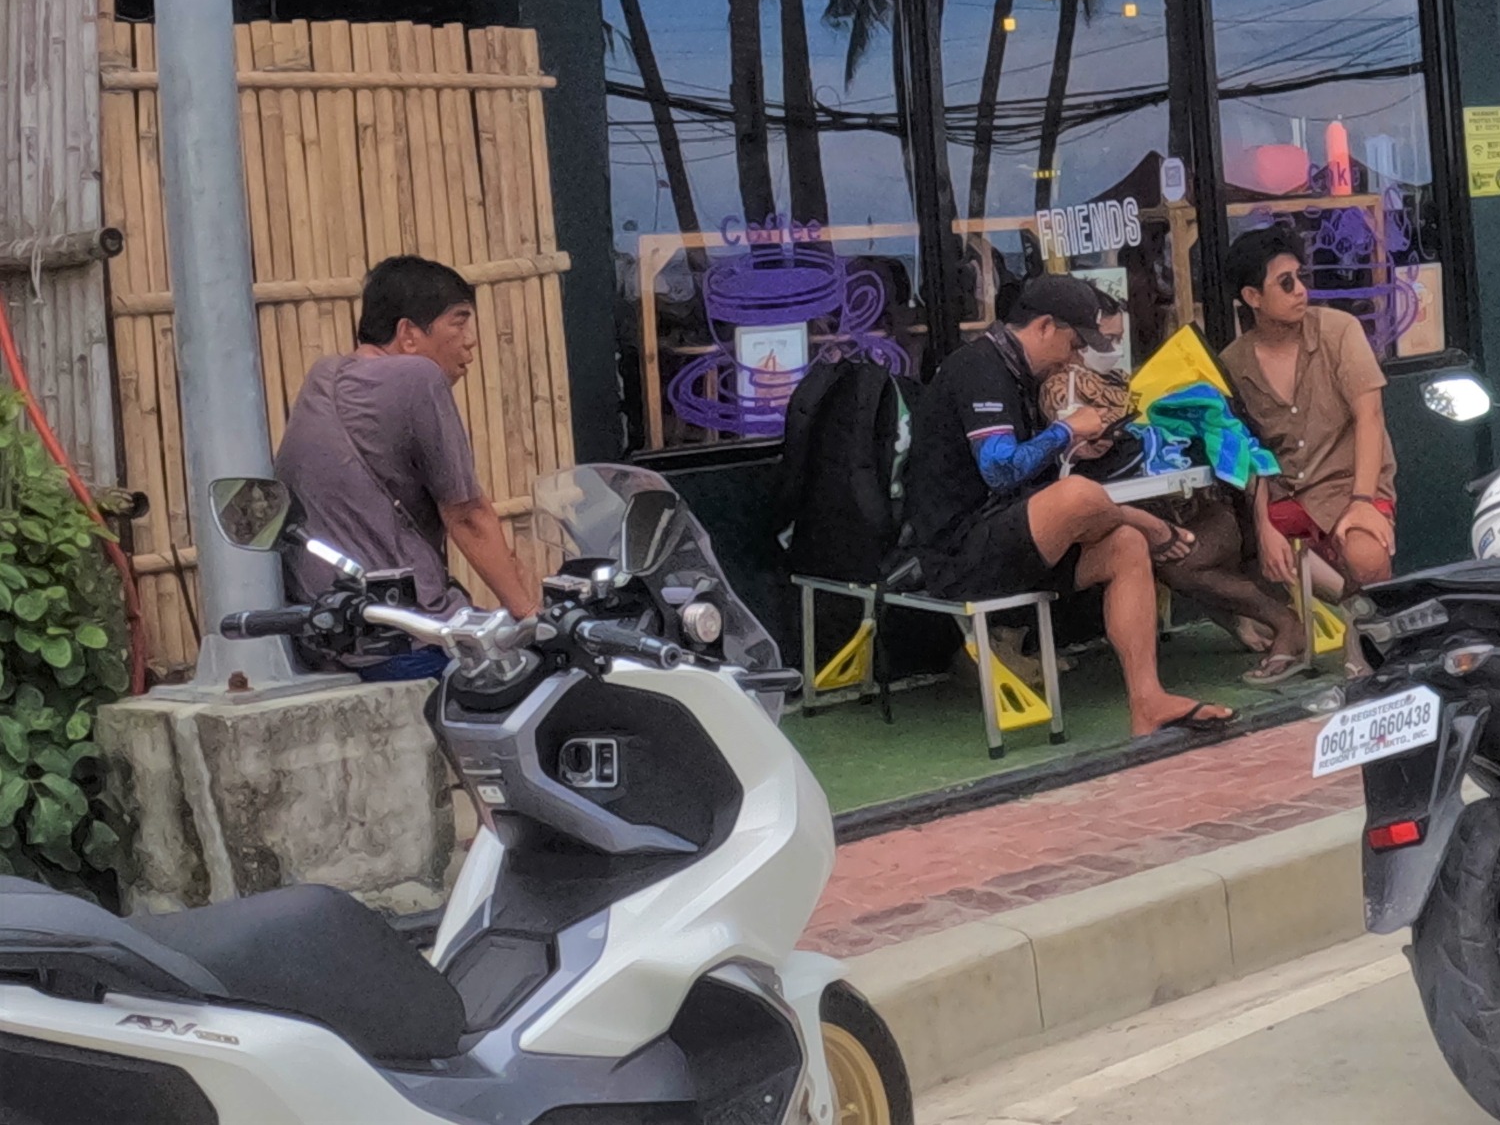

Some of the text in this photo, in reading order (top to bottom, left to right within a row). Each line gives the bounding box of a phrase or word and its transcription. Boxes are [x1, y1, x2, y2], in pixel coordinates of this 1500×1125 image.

[721, 213, 821, 245] Coffee
[1036, 196, 1142, 261] FRIENDS
[1321, 726, 1355, 756] 0601
[1369, 702, 1431, 741] 0660438
[1350, 697, 1409, 724] REGISTERED
